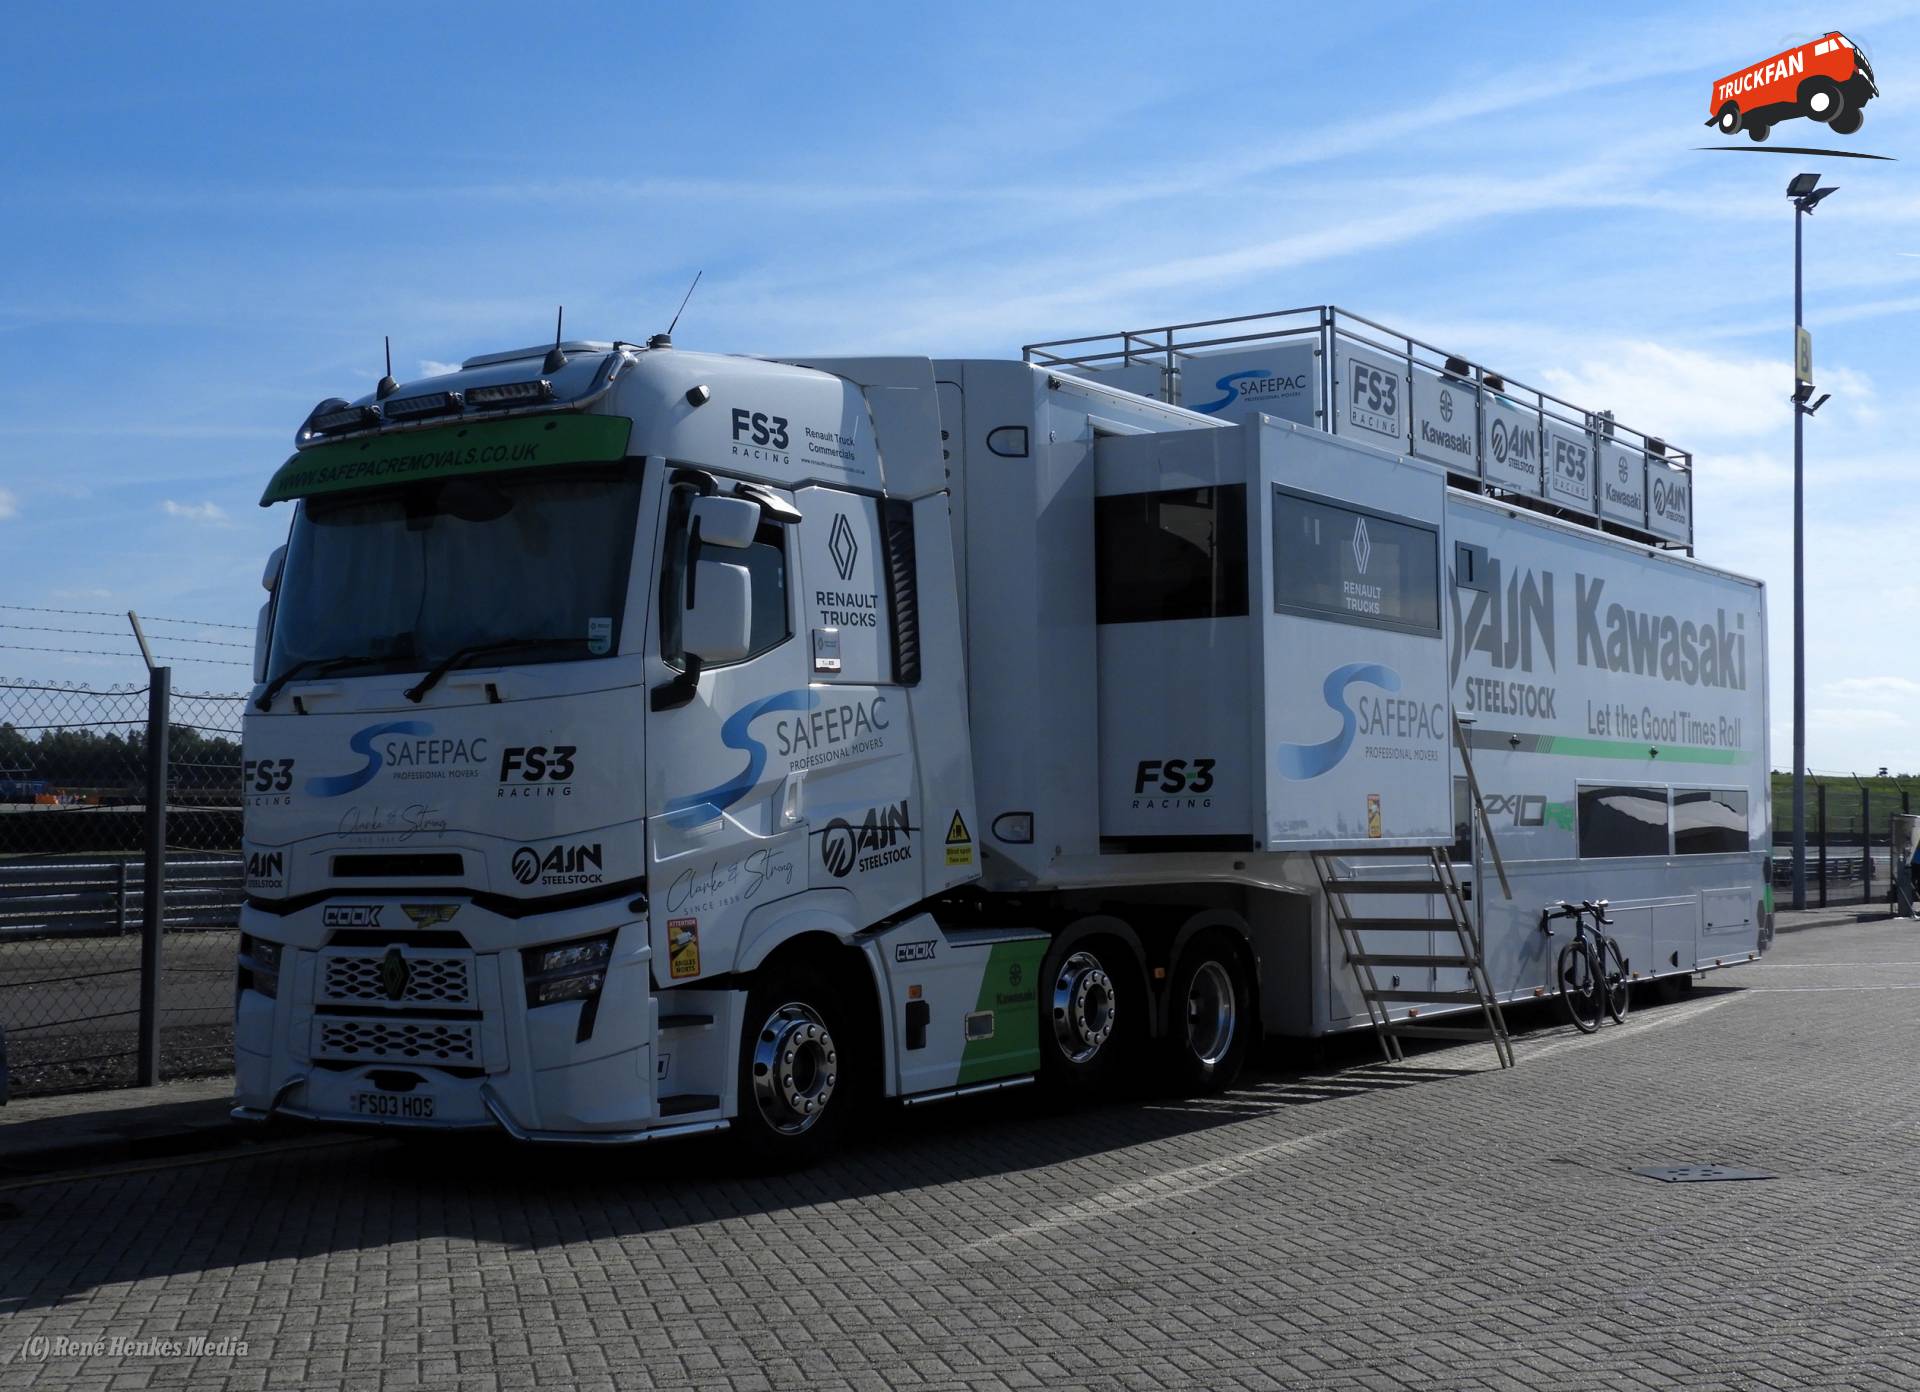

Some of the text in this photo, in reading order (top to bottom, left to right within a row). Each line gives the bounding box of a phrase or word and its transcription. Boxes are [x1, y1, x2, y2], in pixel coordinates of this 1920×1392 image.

[1240, 374, 1306, 395] SAFEPAC
[1352, 411, 1396, 433] RACING
[805, 427, 834, 442] Renault
[1421, 420, 1471, 455] Kawasaki
[1508, 424, 1535, 460] AJN
[732, 446, 789, 465] RACING
[808, 442, 855, 461] Commercials
[277, 442, 540, 494] WWW.SAFEPACREMOVALS.CO.UK
[1508, 458, 1535, 475] STEELSTOCK
[1554, 479, 1585, 497] RACING
[1605, 482, 1641, 511] Kawasaki
[1665, 481, 1686, 511] AJN
[815, 591, 878, 609] RENAULT
[1343, 581, 1381, 600] RENAULT
[1346, 597, 1380, 615] TRUCKS
[1464, 557, 1556, 675] AJN
[820, 610, 876, 628] TRUCKS
[1574, 572, 1747, 691] Kawasaki
[1465, 676, 1557, 720] STEELSTOCK
[776, 696, 889, 757] SAFEPAC
[1359, 695, 1444, 740] SAFEPAC
[1587, 699, 1742, 748] Let the Good Times Roll
[386, 738, 488, 767] SAFEPAC
[789, 736, 884, 772] PROFESSIONAL MOVERS
[1365, 746, 1412, 760] PROFESSIONAL
[393, 768, 479, 780] PROFESSIONAL MOVERS
[497, 786, 572, 799] RACING
[1132, 799, 1211, 809] RACING
[858, 800, 911, 855] AJN
[540, 843, 603, 873] AJN
[858, 845, 912, 873] STEELSTOCK
[541, 873, 603, 886] STEELSTOCK
[666, 861, 726, 914] Clarke
[743, 848, 794, 900] Strong
[683, 901, 715, 917] SINCE
[997, 988, 1035, 1004] Kawasaki
[359, 1094, 398, 1114] FS03
